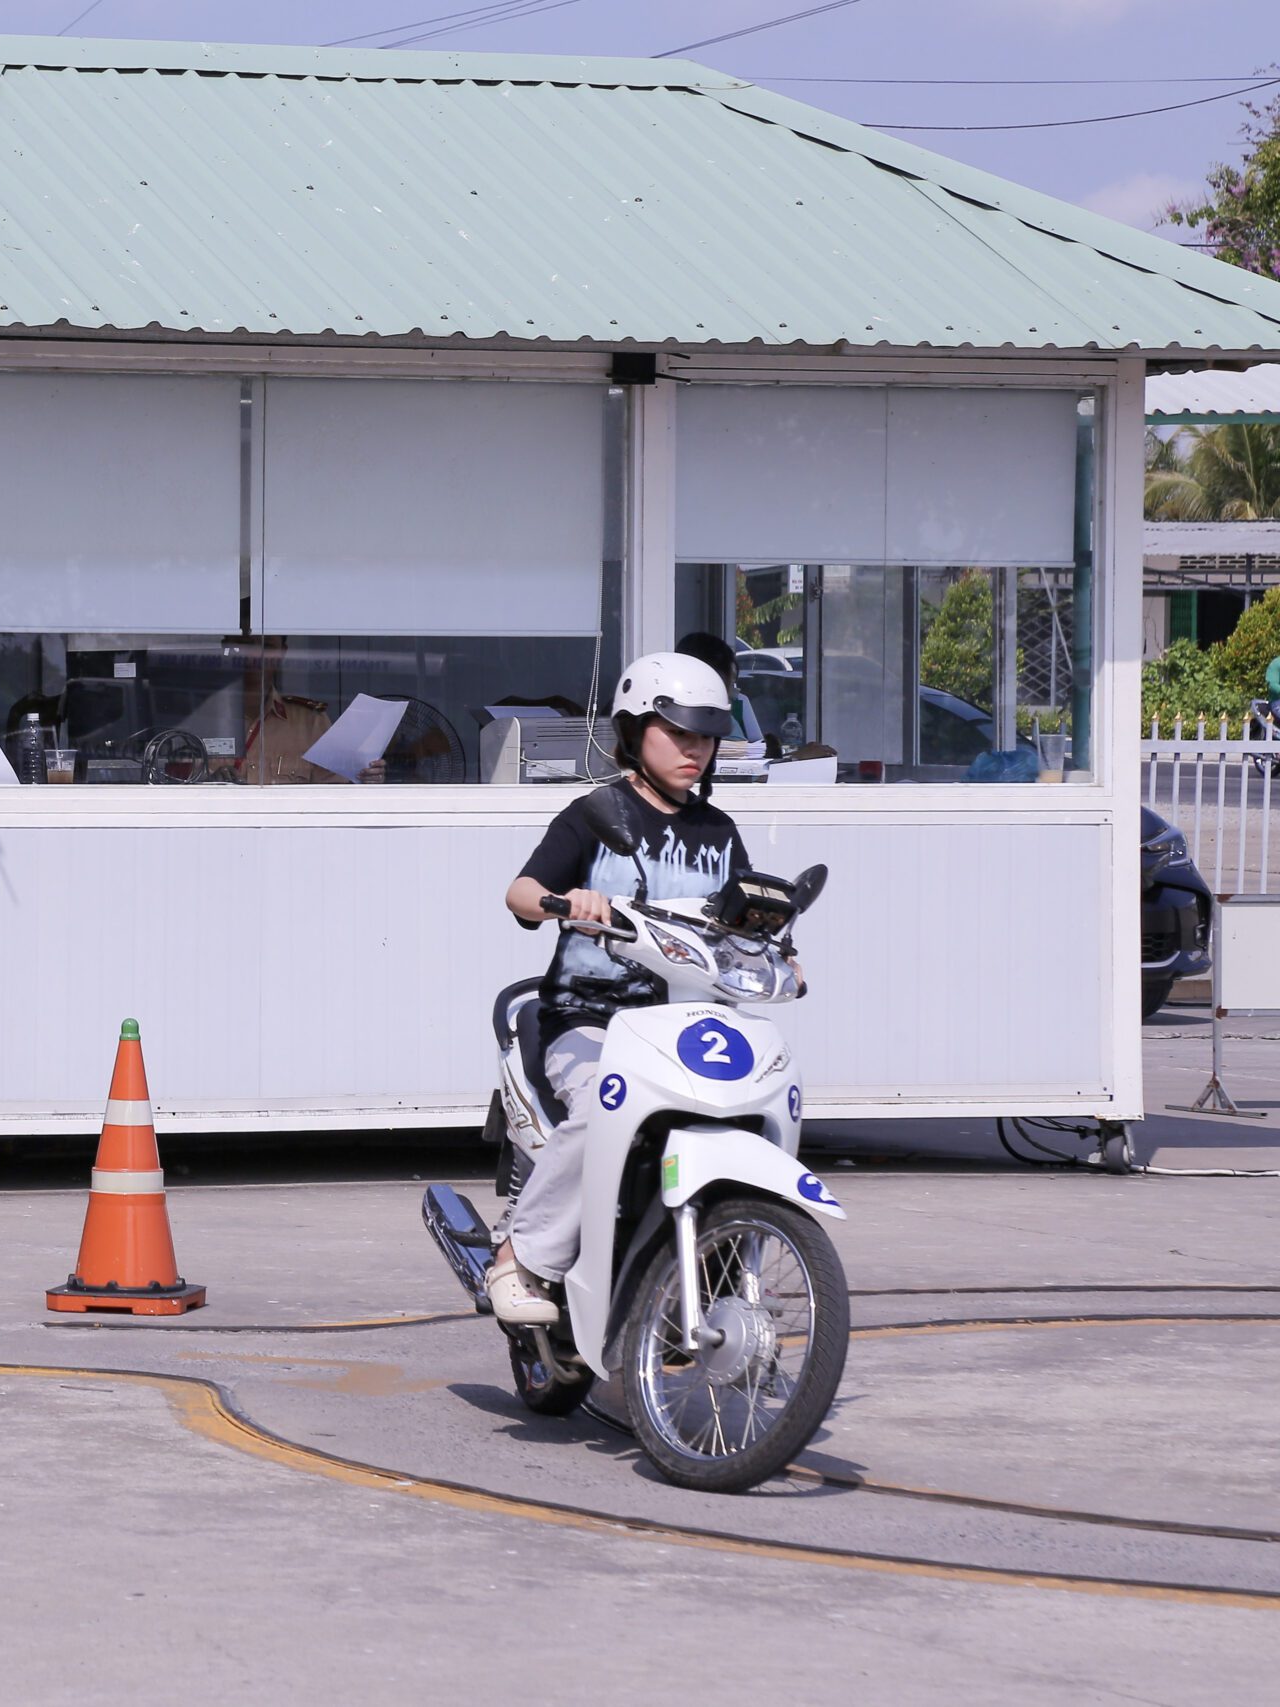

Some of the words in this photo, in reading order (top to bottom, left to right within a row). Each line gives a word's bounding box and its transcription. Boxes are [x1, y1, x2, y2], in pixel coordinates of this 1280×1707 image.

[685, 1009, 729, 1021] HONDA
[700, 1030, 732, 1064] 2
[602, 1077, 622, 1107] 2
[790, 1089, 800, 1118] 2
[806, 1175, 837, 1203] 2
